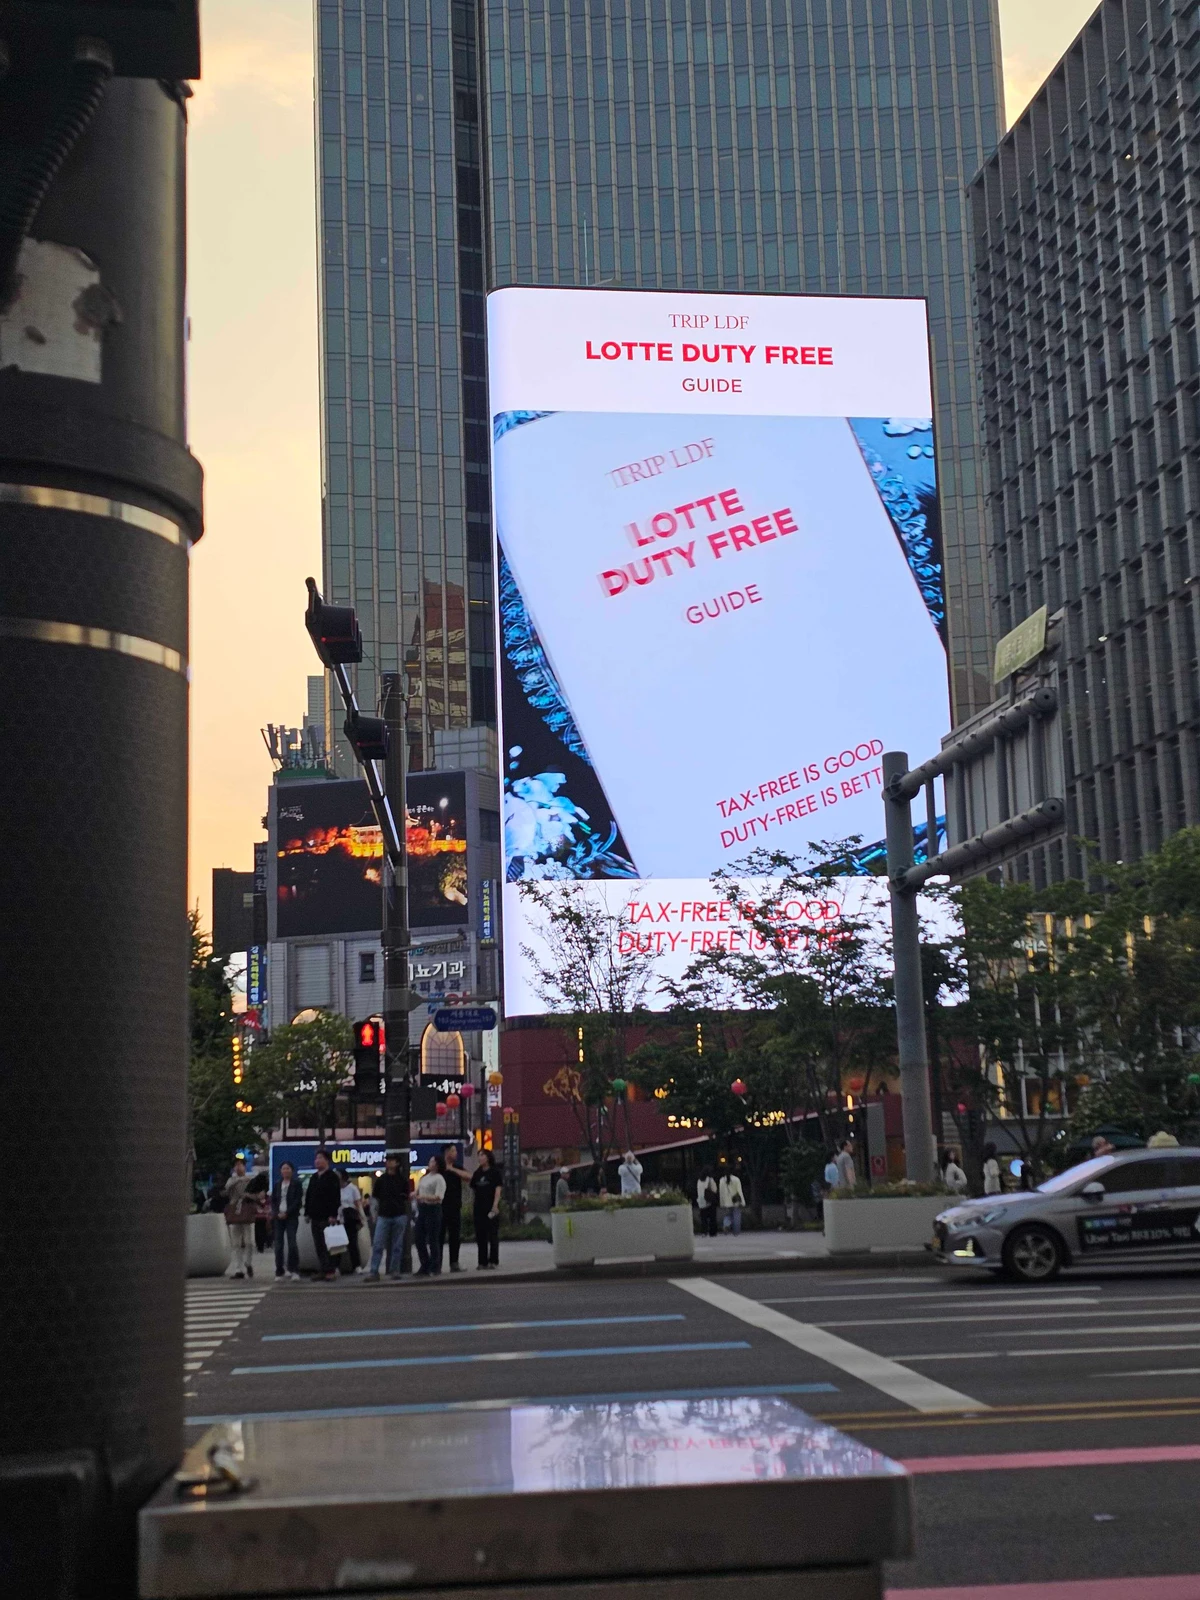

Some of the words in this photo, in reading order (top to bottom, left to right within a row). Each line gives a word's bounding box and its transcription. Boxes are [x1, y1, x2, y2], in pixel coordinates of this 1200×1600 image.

[668, 313, 710, 330] TRIP
[714, 315, 750, 331] LDF
[585, 340, 674, 362] LOTTE
[682, 343, 757, 364] DUTY
[765, 345, 834, 366] FREE
[682, 377, 743, 393] GUIDE
[610, 455, 666, 488] TRIP
[671, 437, 717, 469] LDF
[627, 488, 745, 547] LOTTE
[598, 541, 697, 597] DUTY
[707, 507, 799, 559] FREE
[685, 584, 763, 624] GUIDE
[716, 771, 801, 819] TAX-FREE
[803, 764, 821, 784] IS
[824, 739, 885, 774] GOOD
[720, 794, 819, 849] DUTY-FREE
[820, 790, 838, 807] IS
[840, 766, 884, 798] BETT
[628, 901, 731, 924] TAX-FREE
[738, 900, 757, 921] IS
[618, 928, 740, 954] DUTY-FREE
[748, 930, 766, 951] IS
[408, 960, 467, 981] 뇨기과
